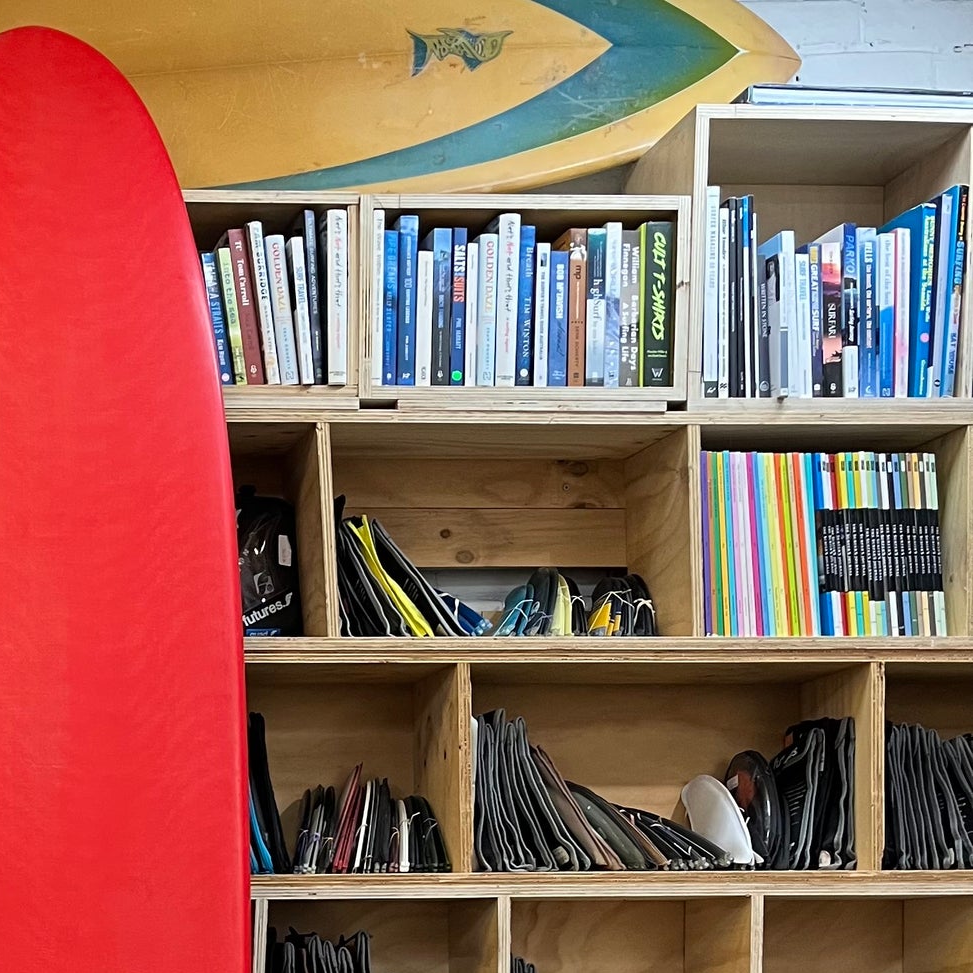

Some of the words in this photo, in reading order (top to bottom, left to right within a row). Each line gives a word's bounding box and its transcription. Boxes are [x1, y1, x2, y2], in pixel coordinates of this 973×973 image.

[235, 241, 243, 252] TC
[454, 245, 466, 273] SALTS
[653, 232, 667, 270] CULT
[846, 234, 856, 274] PARKO
[237, 259, 245, 277] Tom
[272, 242, 282, 285] GOLDEN
[296, 266, 304, 282] SURF
[386, 255, 397, 289] DREAMS
[485, 241, 495, 284] GOLDEN
[506, 257, 515, 271] and
[525, 247, 534, 278] Breath
[556, 264, 565, 281] BOB
[574, 265, 582, 280] mp
[621, 243, 630, 287] Finnegan
[631, 247, 639, 284] William
[954, 241, 965, 285] SURFING
[239, 278, 249, 306] Carroll
[404, 278, 413, 288] 100
[453, 276, 465, 303] SUITS
[811, 265, 819, 291] GREAT
[226, 288, 234, 304] the
[297, 284, 306, 304] TRAVEL
[310, 275, 319, 314] ADVENTURES
[485, 286, 493, 313] DAZE
[524, 297, 532, 314] TIM
[651, 272, 666, 341] T-SHIRTS
[211, 302, 223, 334] STRAITS
[229, 308, 237, 325] sea
[621, 311, 629, 344] Surfing
[630, 295, 639, 344] Barbarian
[761, 310, 767, 318] IN
[827, 303, 837, 339] SURFARI
[522, 319, 531, 358] WINTON
[621, 346, 629, 362] Life
[629, 347, 638, 371] Days
